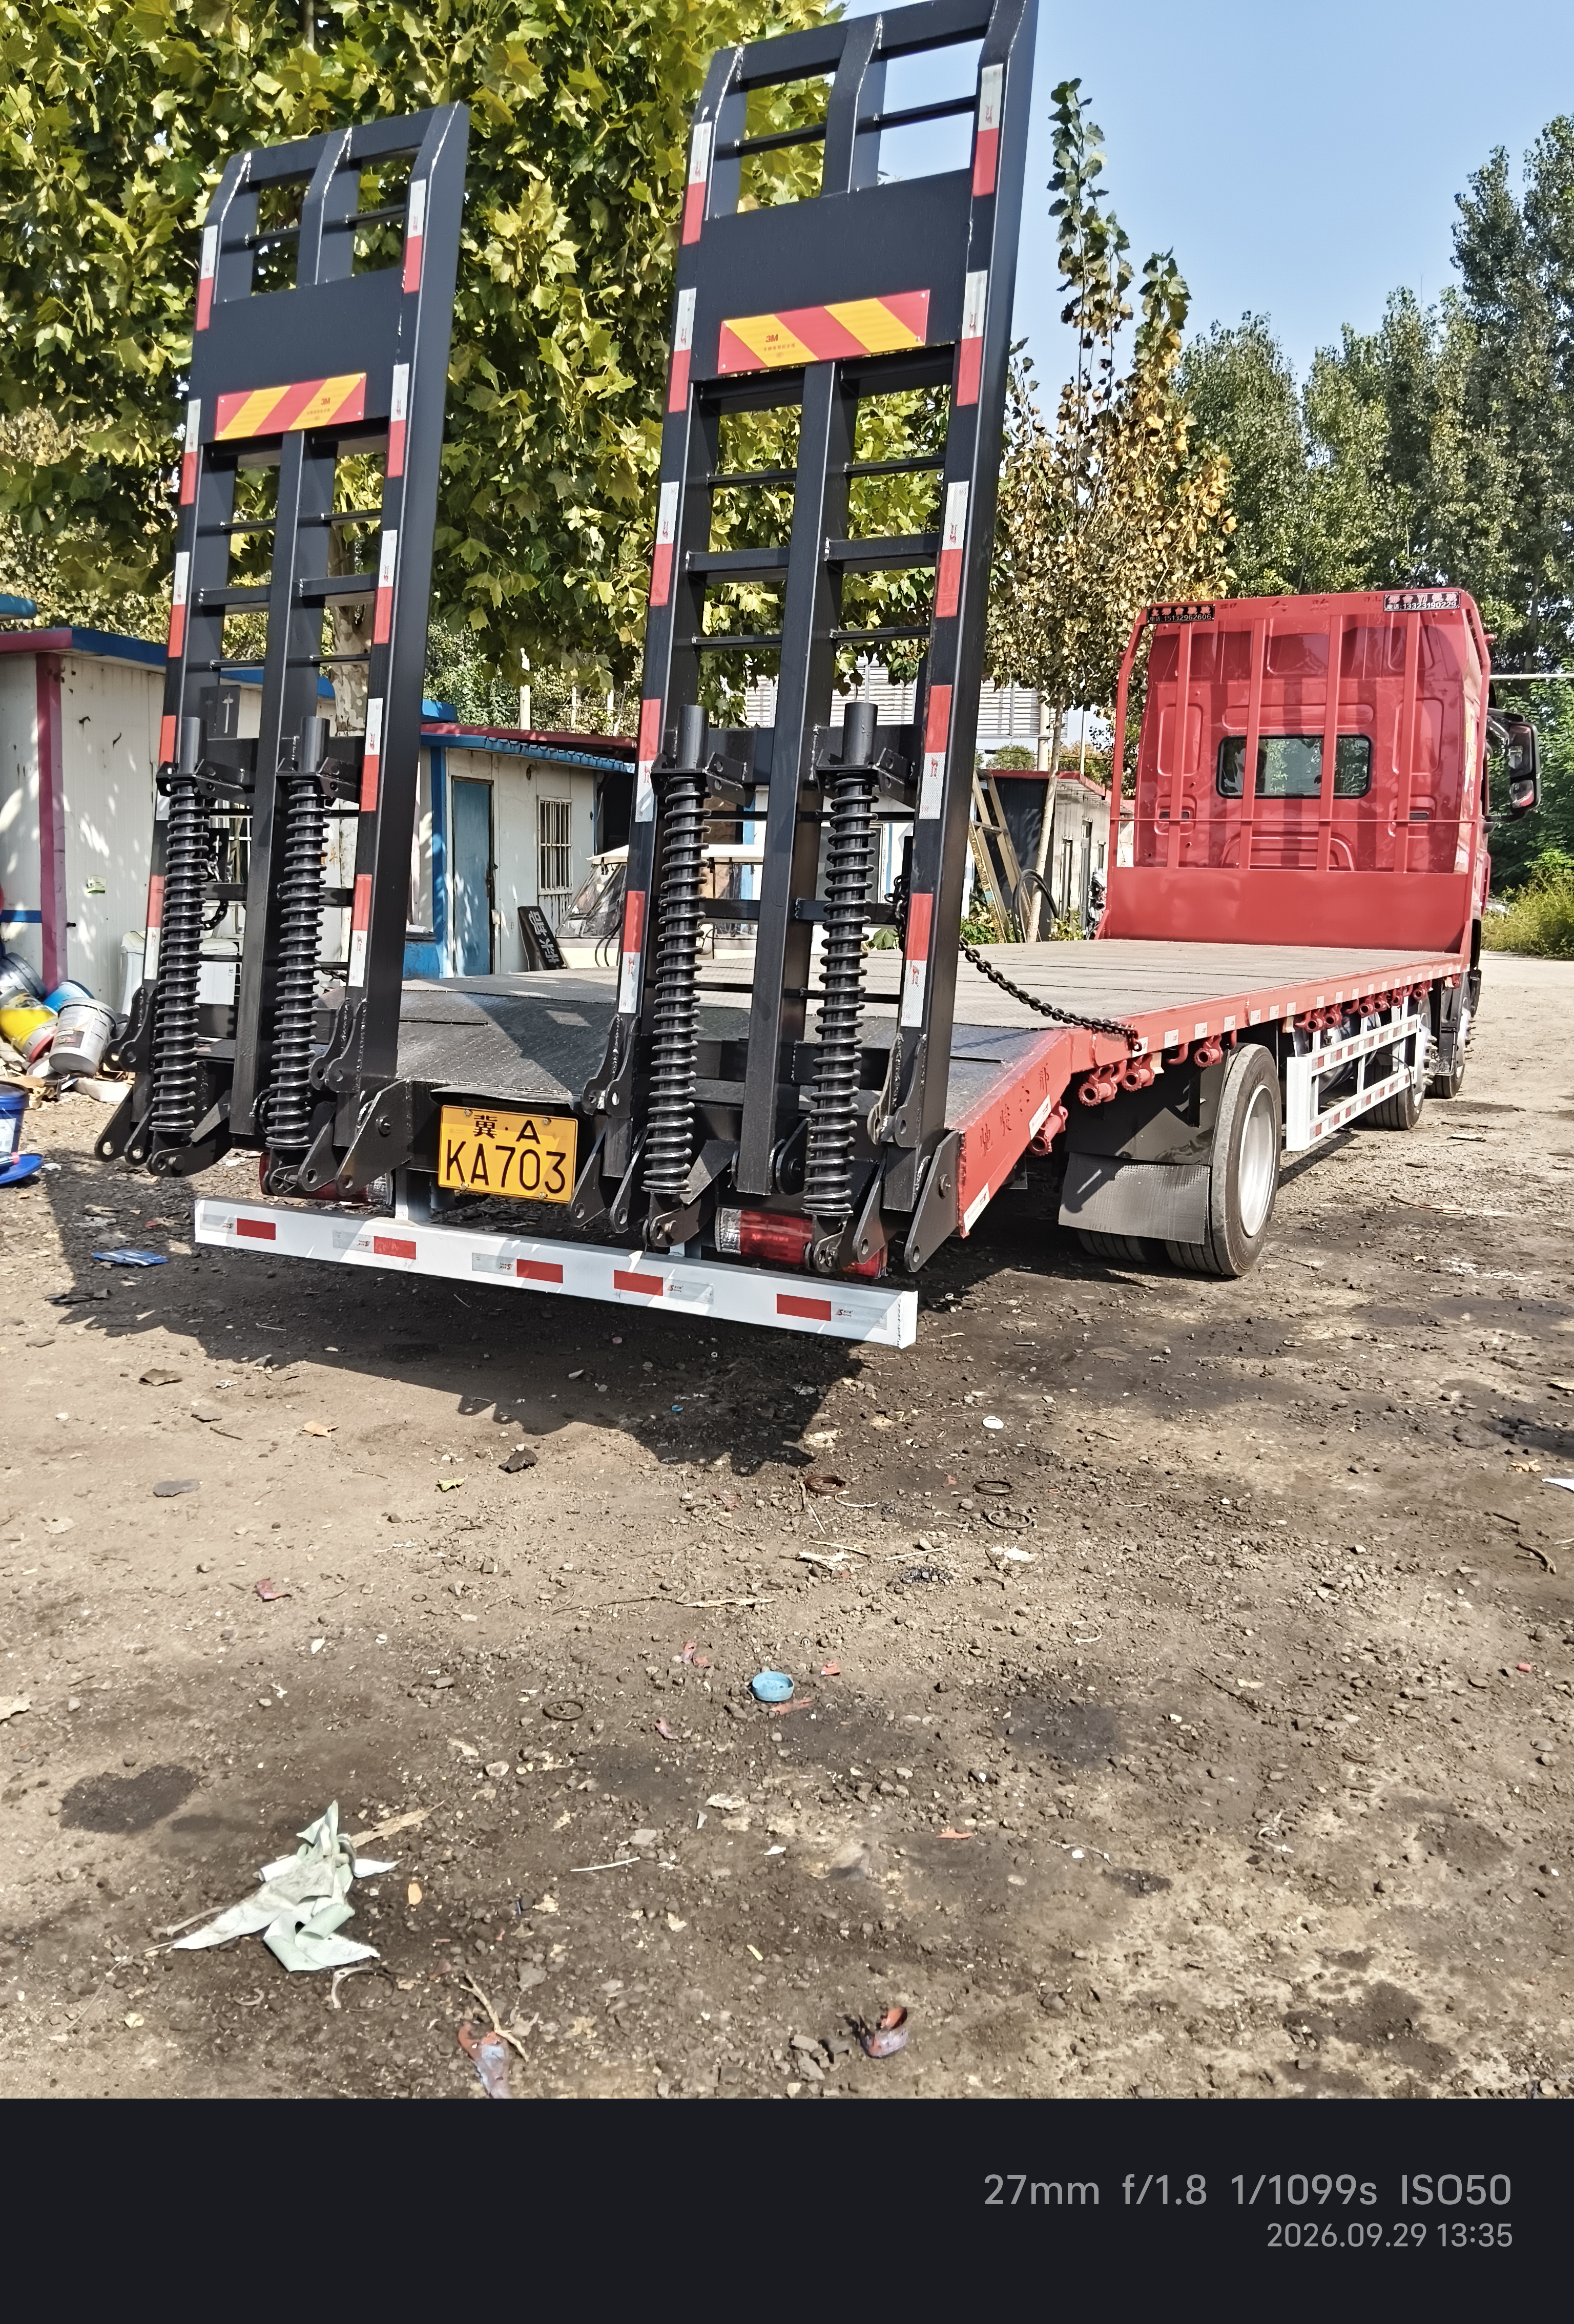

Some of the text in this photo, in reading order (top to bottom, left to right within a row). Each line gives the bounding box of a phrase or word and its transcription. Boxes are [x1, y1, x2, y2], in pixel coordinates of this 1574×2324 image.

[765, 334, 778, 343] 3M
[528, 910, 560, 969] 卖部
[446, 1139, 567, 1194] KA703
